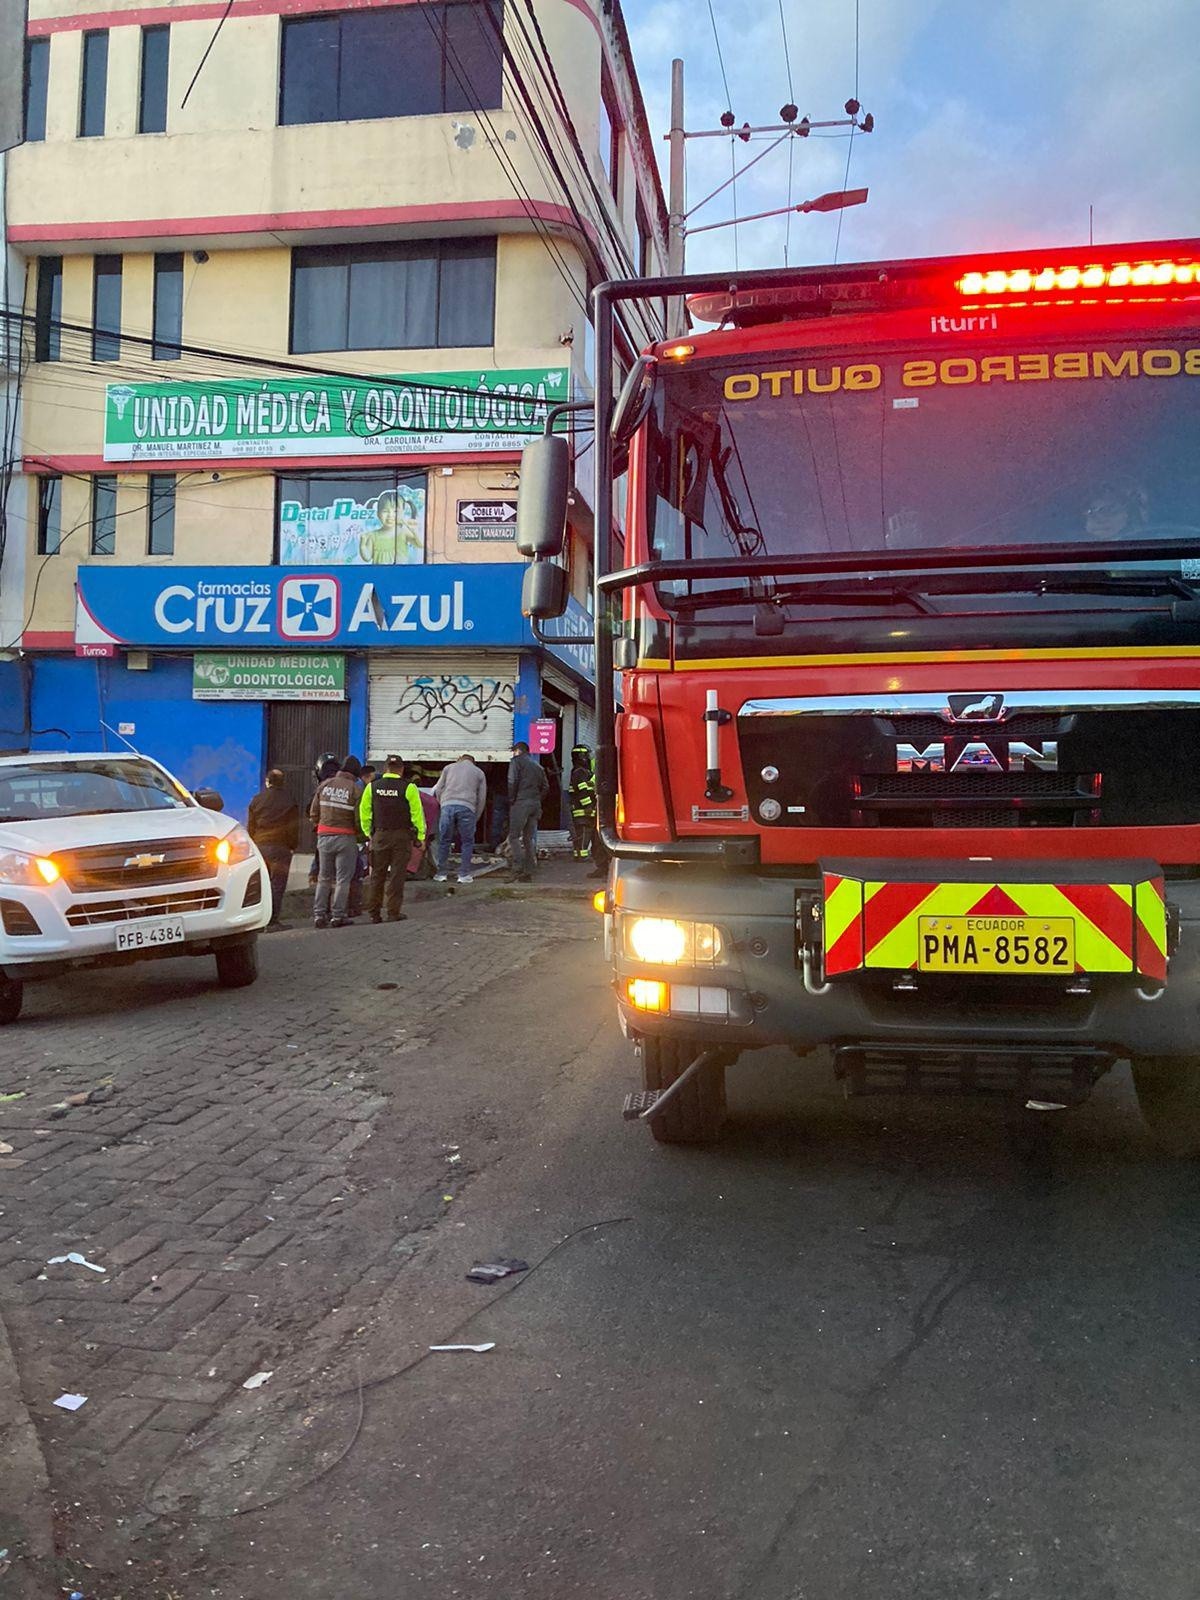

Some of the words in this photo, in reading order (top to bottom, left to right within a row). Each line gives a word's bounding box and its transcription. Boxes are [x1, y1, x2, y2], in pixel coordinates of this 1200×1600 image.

[931, 313, 997, 333] iturri
[133, 393, 229, 438] UNIDAD
[236, 382, 332, 436] MÉDICA
[340, 389, 358, 433] Y
[364, 374, 549, 432] ODONTOLÓGICA
[146, 442, 174, 451] MANUEL
[177, 441, 212, 450] MARTINEZ
[364, 437, 381, 446] DRA.
[384, 436, 421, 445] CAROLINA
[472, 507, 492, 516] DOBLE
[494, 507, 506, 516] VIA
[198, 581, 271, 596] farmacias
[154, 585, 272, 633] Cruz
[305, 602, 313, 614] F
[227, 656, 276, 668] UNIDAD
[335, 657, 342, 669] Y
[233, 672, 336, 686] ODONTOLÓGICA
[896, 741, 1058, 772] MAN
[967, 920, 1025, 931] ECUADOR
[118, 926, 182, 948] PFB-4384
[924, 935, 1068, 965] PMA-8582
